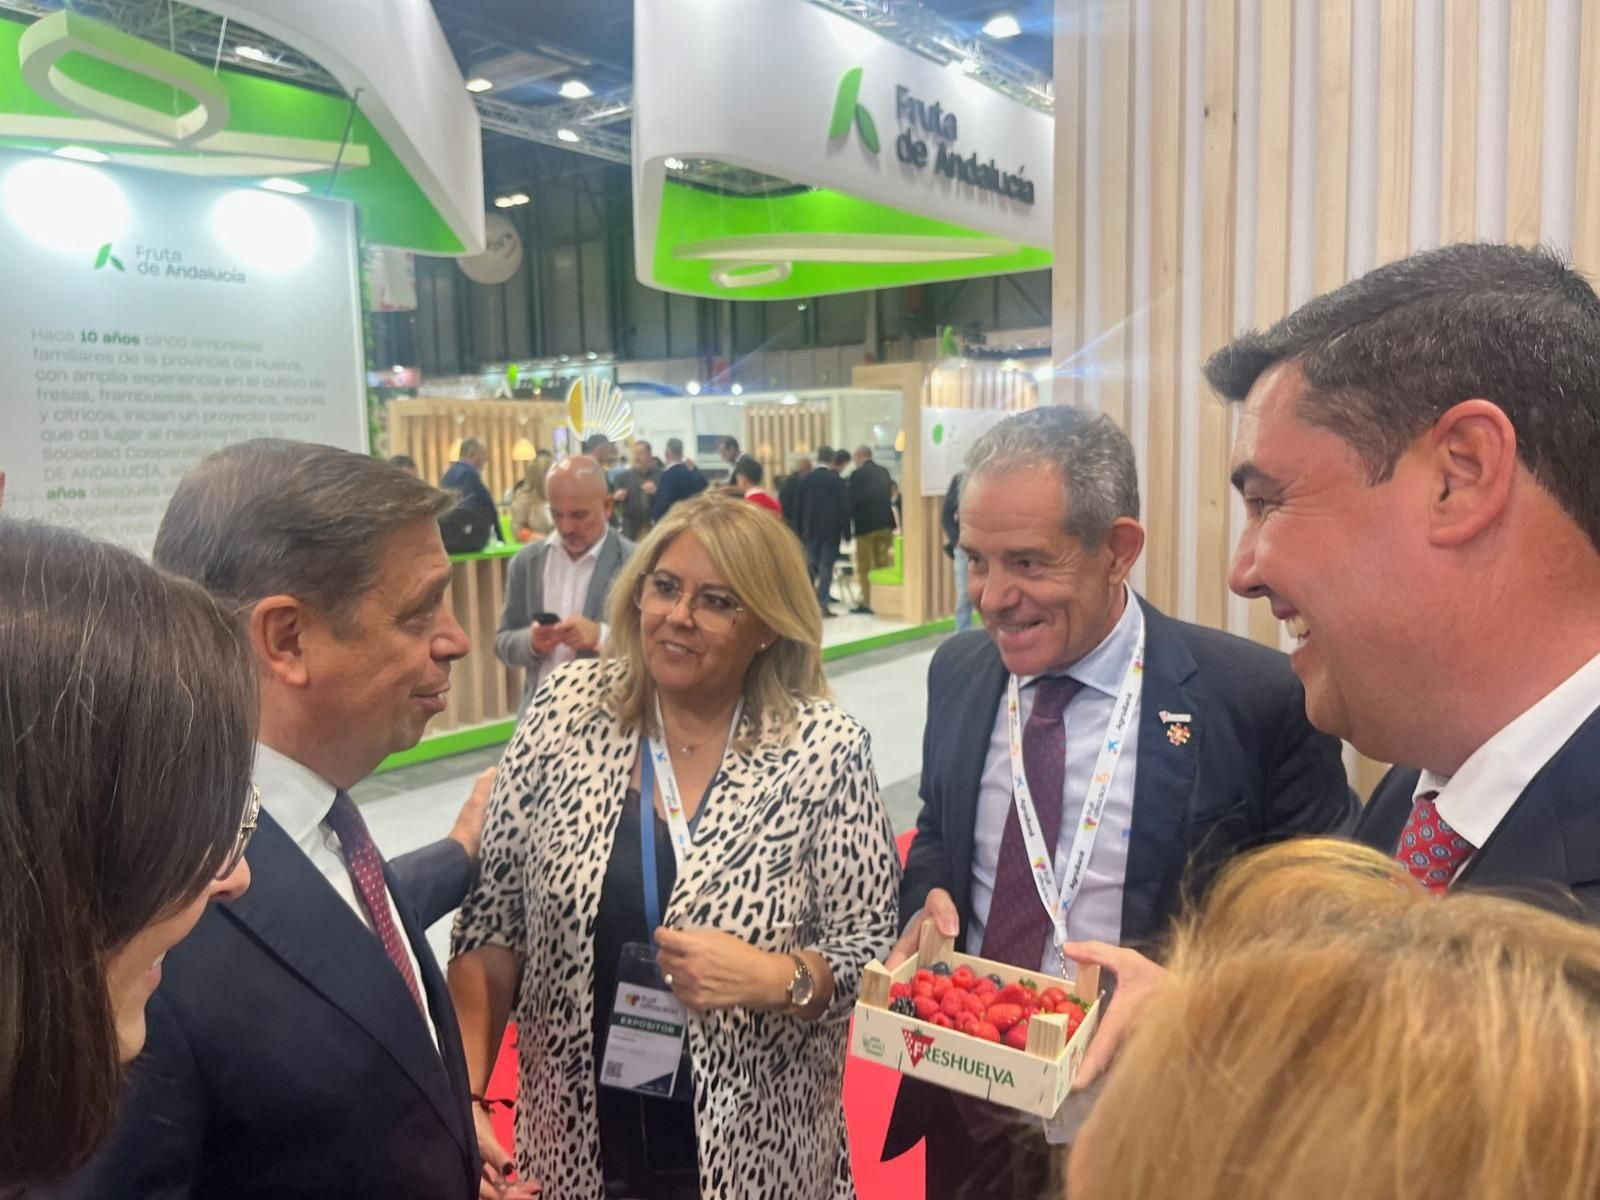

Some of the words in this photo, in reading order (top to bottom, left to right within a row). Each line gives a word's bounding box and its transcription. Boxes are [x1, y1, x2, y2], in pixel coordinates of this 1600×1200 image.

[896, 84, 957, 141] Fruta
[896, 128, 928, 169] de
[934, 143, 1035, 205] Andalucía
[135, 243, 183, 264] Fruta
[136, 261, 160, 277] de
[165, 263, 247, 284] Andalucía
[32, 329, 75, 343] Hace
[80, 331, 98, 345] 10
[103, 331, 141, 346] años
[145, 334, 188, 349] cinco
[191, 338, 263, 352] empresas
[33, 347, 114, 364] familiares
[118, 352, 139, 366] de
[144, 352, 158, 366] la
[162, 354, 230, 370] provincia
[233, 357, 253, 370] de
[35, 368, 68, 383] con
[73, 367, 129, 386] amplia
[132, 370, 221, 389] experiencia
[224, 375, 244, 387] en
[247, 374, 260, 387] el
[263, 376, 306, 389] cultivo
[36, 387, 96, 403] fresas,
[99, 387, 195, 405] frambuesas,
[38, 409, 49, 424] y
[54, 407, 120, 424] cítricos,
[124, 408, 175, 422] inician
[179, 411, 199, 423] un
[203, 410, 267, 426] proyecto
[270, 410, 316, 423] común
[41, 429, 73, 443] que
[78, 427, 99, 441] da
[103, 427, 142, 445] lugar
[166, 428, 247, 443] nacimiento
[43, 447, 121, 461] Sociedad
[44, 467, 67, 482] DE
[46, 486, 87, 500] años
[91, 485, 160, 501] después
[619, 1016, 675, 1034] EXPOSITOR
[912, 1042, 1016, 1088] FRESHUELVA
